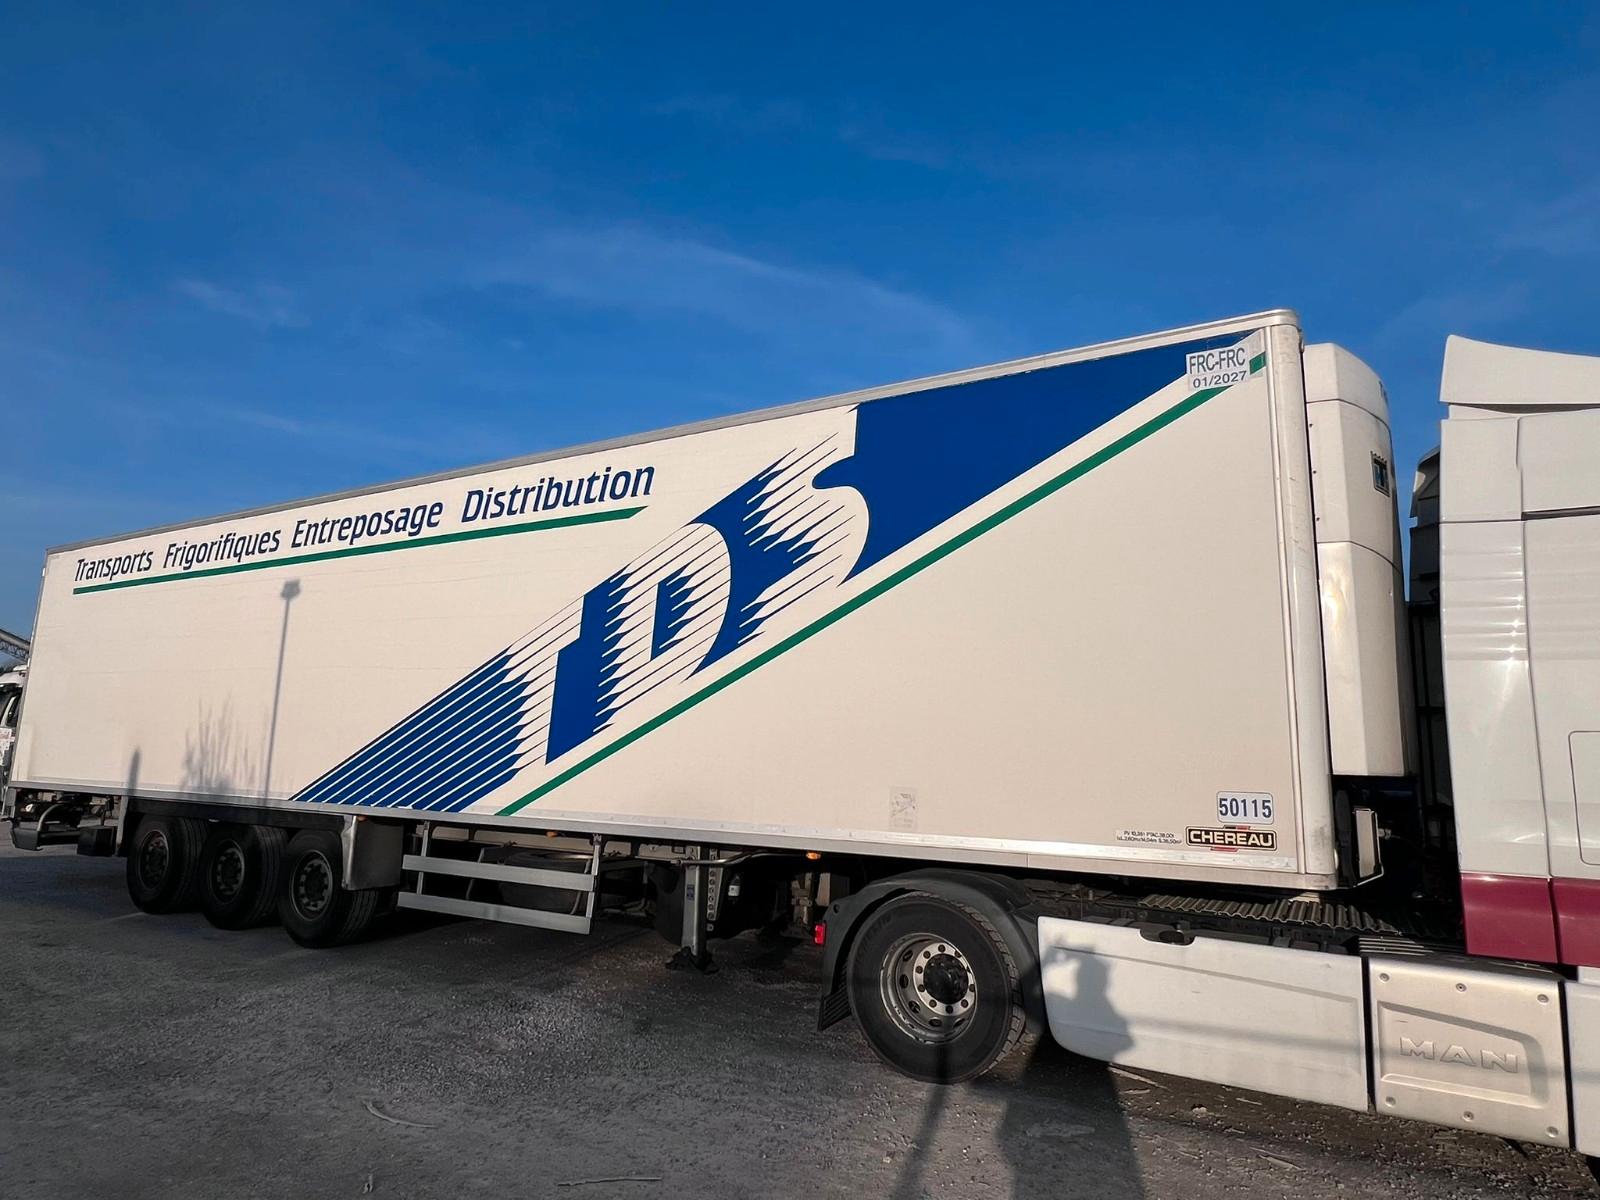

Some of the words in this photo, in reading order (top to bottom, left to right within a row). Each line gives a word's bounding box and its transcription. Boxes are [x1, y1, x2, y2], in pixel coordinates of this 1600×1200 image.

[1189, 347, 1246, 374] FRC-FRC
[1193, 371, 1247, 388] 01/2027
[75, 549, 153, 581] Transports
[163, 529, 281, 571] Frigorifiques
[291, 501, 443, 545] Entreposage
[461, 466, 655, 523] Distribution
[1219, 798, 1272, 818] 50115
[1190, 830, 1273, 847] CHEREAU
[1400, 1036, 1518, 1074] MAN
